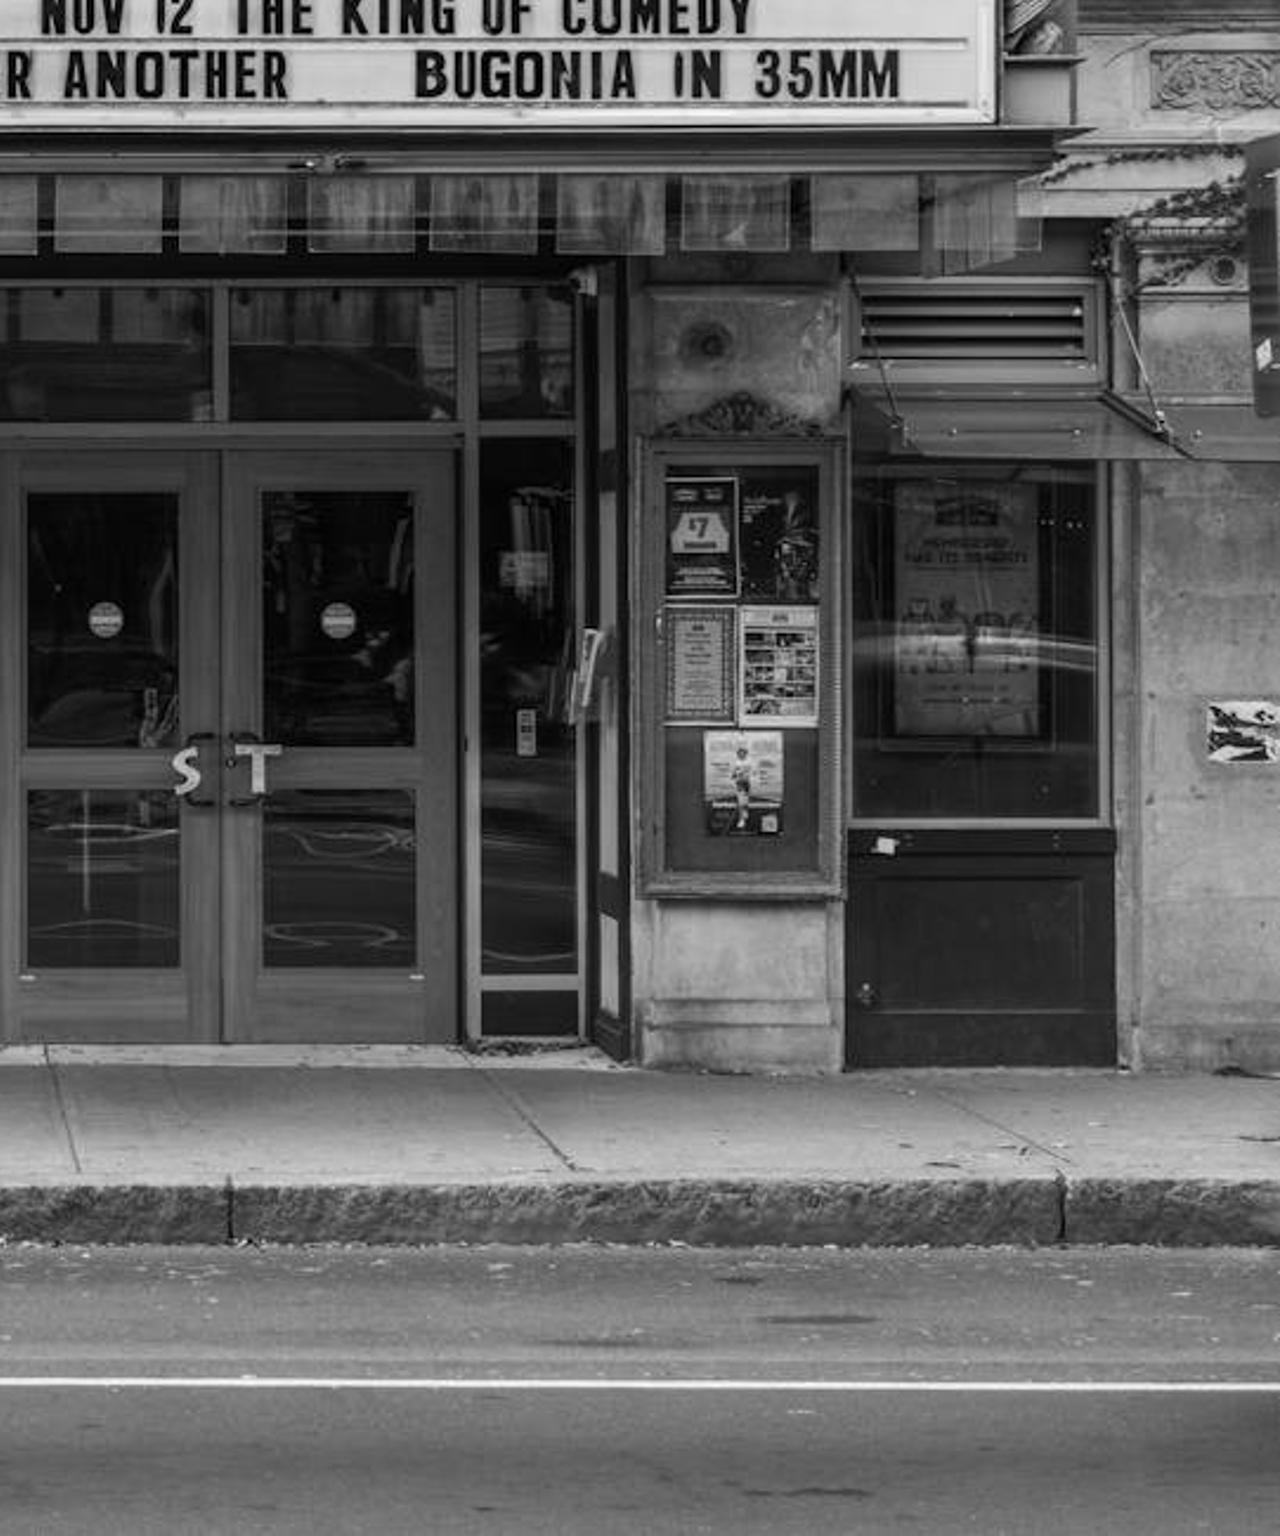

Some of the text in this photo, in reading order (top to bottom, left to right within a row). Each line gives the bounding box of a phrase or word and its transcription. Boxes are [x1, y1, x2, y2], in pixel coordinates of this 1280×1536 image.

[63, 49, 288, 100] ANOTHER
[415, 49, 636, 100] BUGONIA
[674, 49, 721, 99] IN
[755, 49, 899, 99] 35MM
[171, 744, 282, 795] S T
